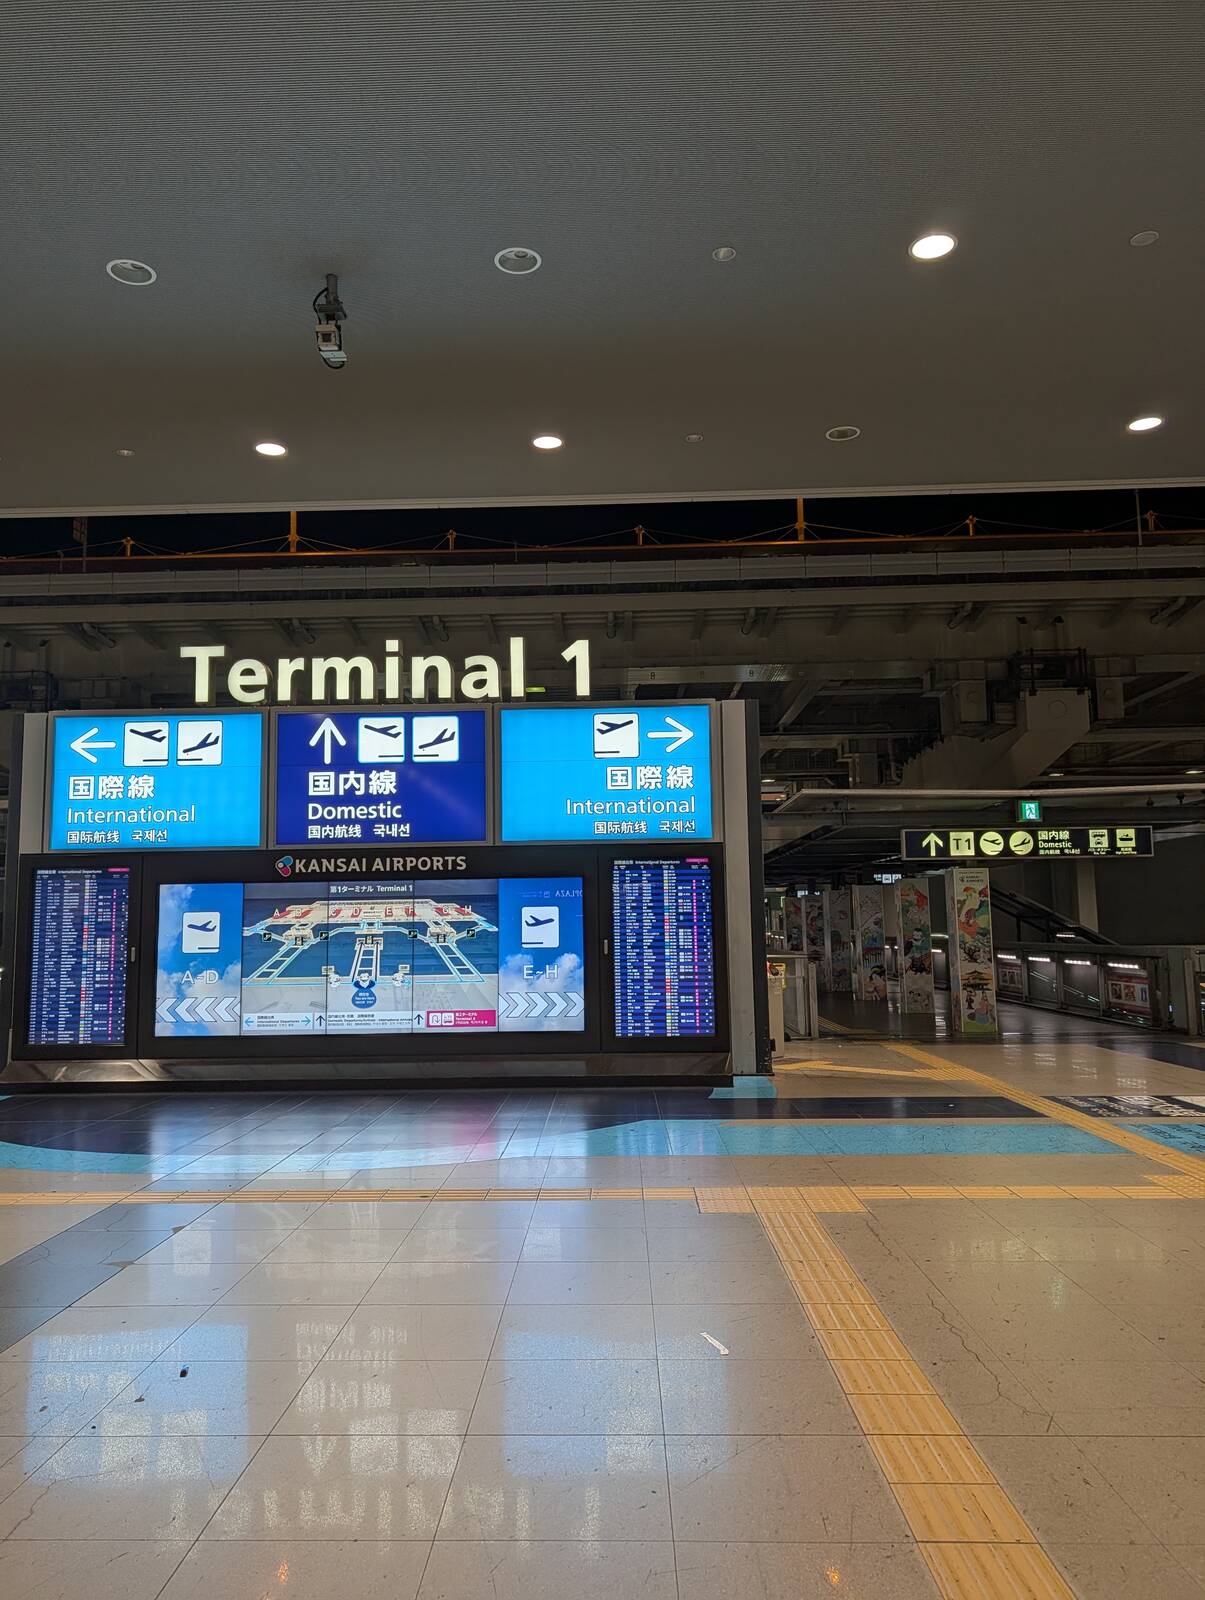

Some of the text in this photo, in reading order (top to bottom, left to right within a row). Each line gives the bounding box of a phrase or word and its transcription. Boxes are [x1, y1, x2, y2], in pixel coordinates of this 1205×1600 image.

[179, 637, 592, 704] Terminal 1
[308, 770, 397, 796] 国内線
[606, 765, 694, 790] 国際線
[68, 774, 155, 800] 国際線
[308, 800, 402, 820] Domestic
[566, 795, 696, 815] International
[67, 804, 196, 824] International
[307, 823, 411, 839] 国内航线 국내선
[594, 819, 696, 835] 国际航线 국제선
[1038, 830, 1070, 840] 国内線
[67, 829, 168, 844] 国际航线 국제선
[952, 838, 971, 850] T1
[295, 855, 467, 873] KANSAI AIRPORTS
[330, 885, 374, 893] 第1ターミナル
[376, 884, 407, 892] Terminal
[273, 908, 280, 917] A
[331, 907, 337, 916] C
[353, 907, 360, 916] D
[386, 907, 392, 915] E
[464, 904, 472, 913] H
